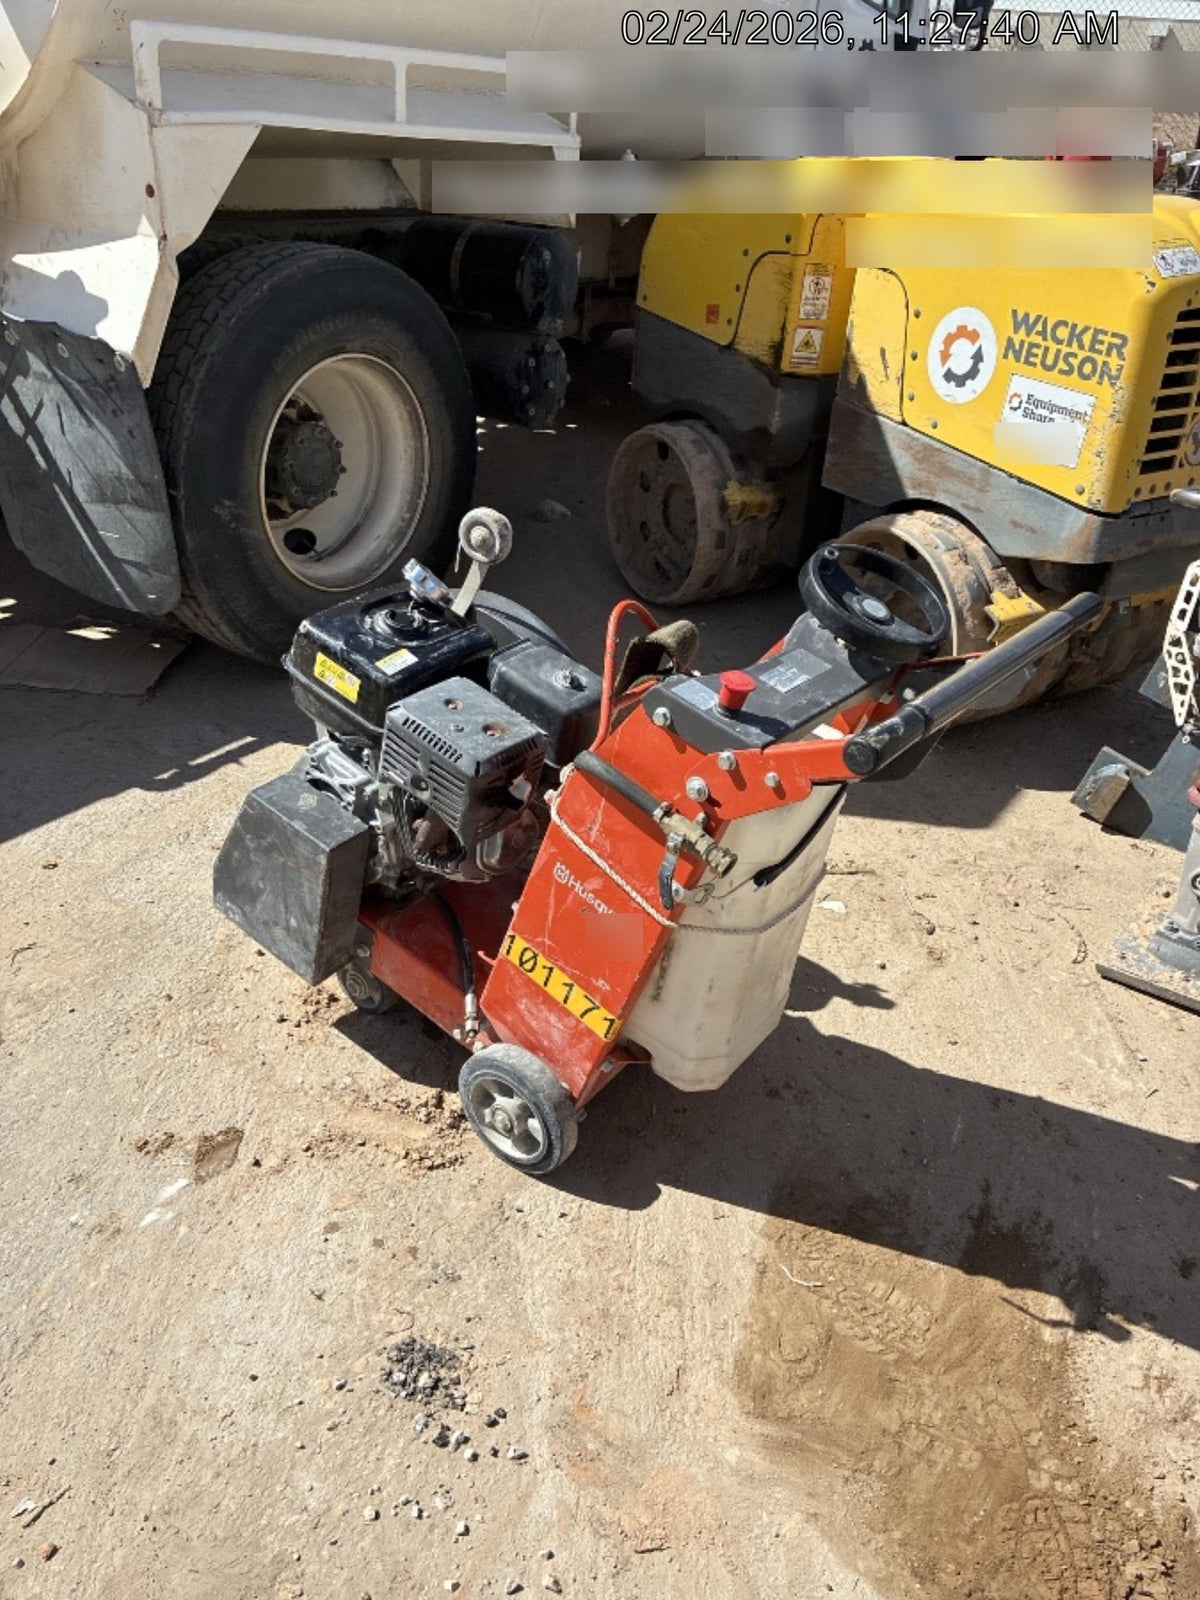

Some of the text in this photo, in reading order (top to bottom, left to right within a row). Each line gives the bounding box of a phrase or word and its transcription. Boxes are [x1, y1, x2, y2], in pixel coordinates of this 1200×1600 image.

[1011, 309, 1129, 361] WACKER
[1002, 336, 1125, 389] NEUSON
[1025, 392, 1089, 424] Equipment
[505, 934, 616, 1039] 101171
